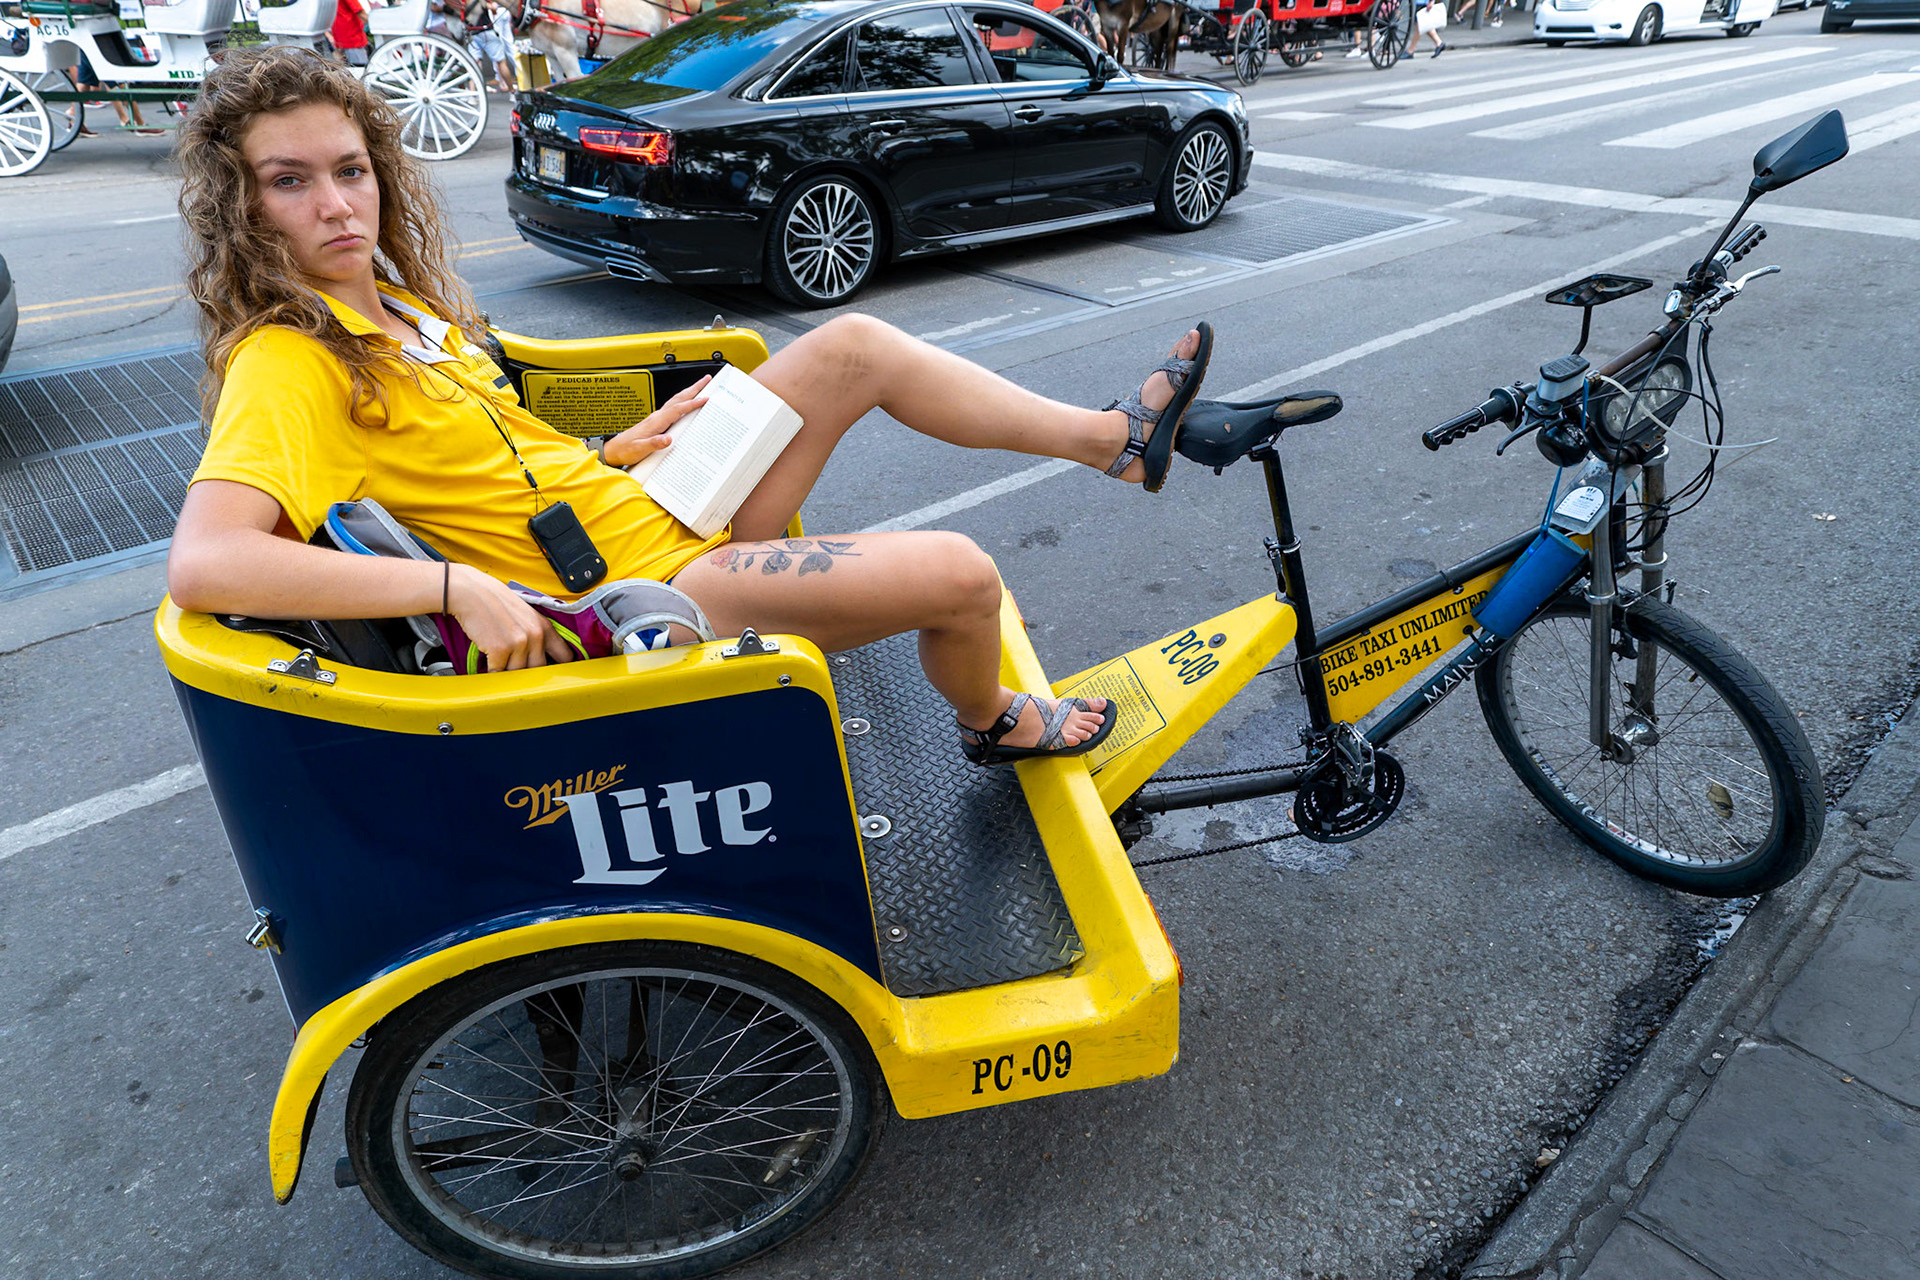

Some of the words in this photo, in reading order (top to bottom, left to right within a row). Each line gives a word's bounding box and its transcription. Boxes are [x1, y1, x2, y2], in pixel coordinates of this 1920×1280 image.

[56, 25, 70, 36] 16
[167, 70, 204, 79] MID-
[1160, 629, 1220, 686] PC-09
[1320, 646, 1358, 674] BIKE
[1360, 627, 1398, 656] TAXI
[1327, 635, 1442, 697] 504-891-3441
[1125, 674, 1141, 696] PEDICAB
[1138, 695, 1151, 712] FARES
[1423, 656, 1478, 704] MAIN
[504, 763, 626, 830] Miller
[553, 780, 773, 886] Lite
